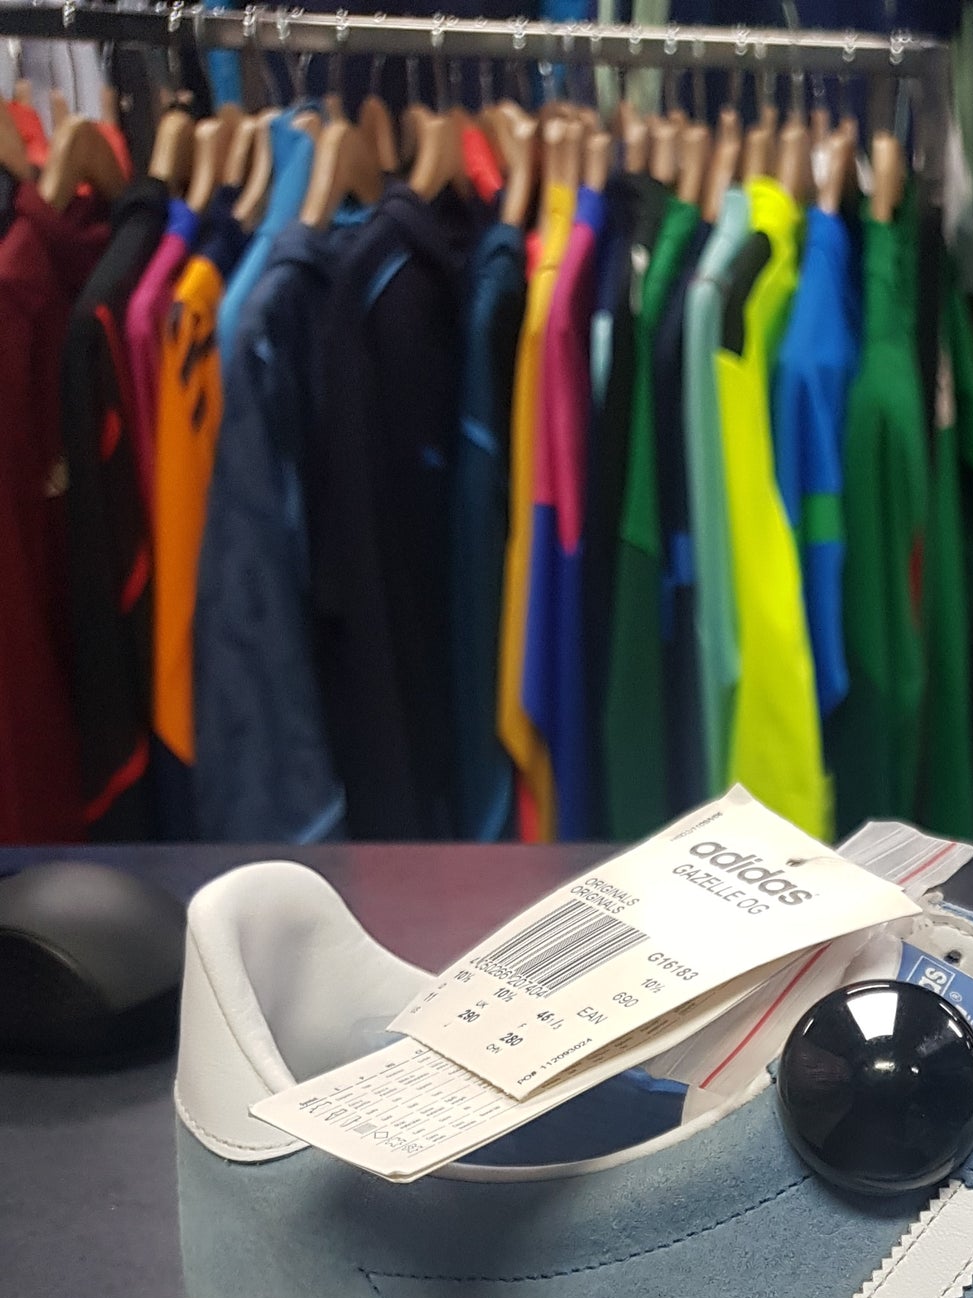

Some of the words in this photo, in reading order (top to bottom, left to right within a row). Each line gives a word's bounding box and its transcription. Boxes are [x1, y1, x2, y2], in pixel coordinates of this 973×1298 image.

[688, 841, 813, 906] adidas
[570, 885, 625, 914] ORIGINALS
[584, 877, 640, 907] ORIGINALS
[672, 863, 747, 902] GAZELLE
[736, 898, 770, 915] OG
[647, 952, 699, 981] G16183
[612, 991, 639, 1008] 690
[576, 1006, 609, 1025] EAN
